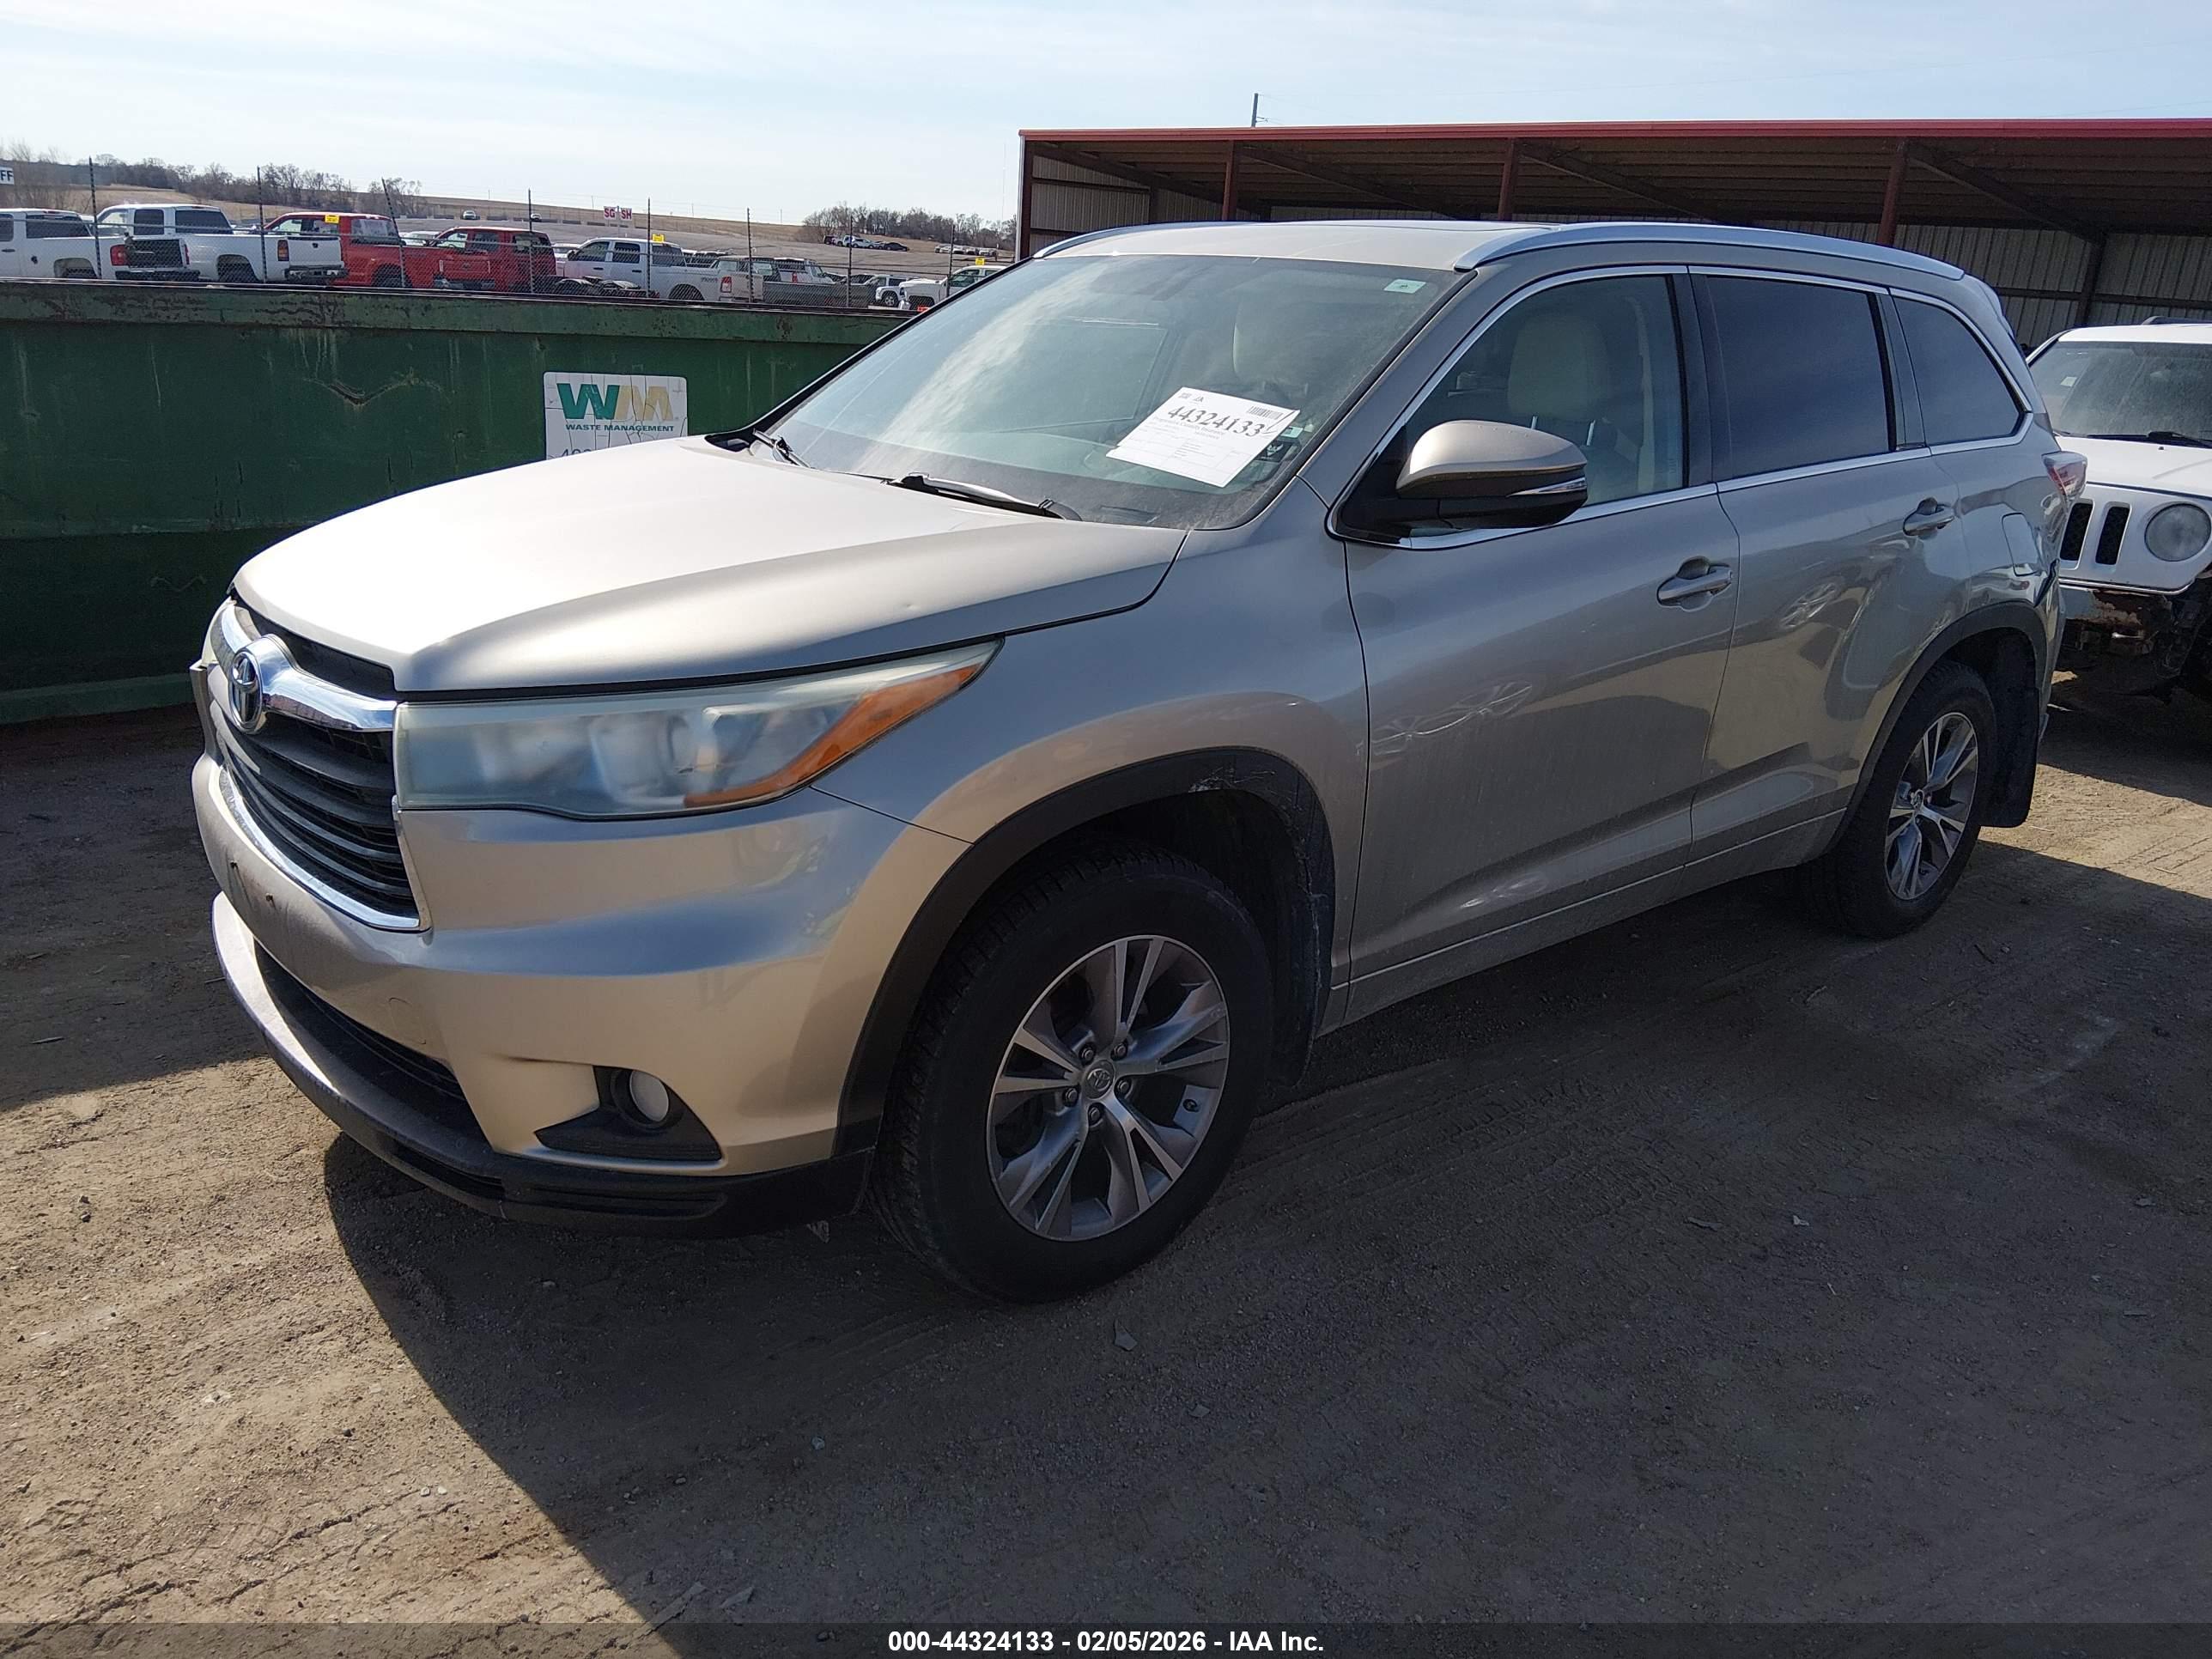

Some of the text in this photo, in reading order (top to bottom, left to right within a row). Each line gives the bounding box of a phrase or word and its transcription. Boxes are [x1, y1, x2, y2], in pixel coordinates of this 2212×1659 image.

[604, 208, 616, 218] SG
[621, 209, 632, 220] SH
[556, 383, 674, 421] WM
[1168, 406, 1266, 437] 44324133
